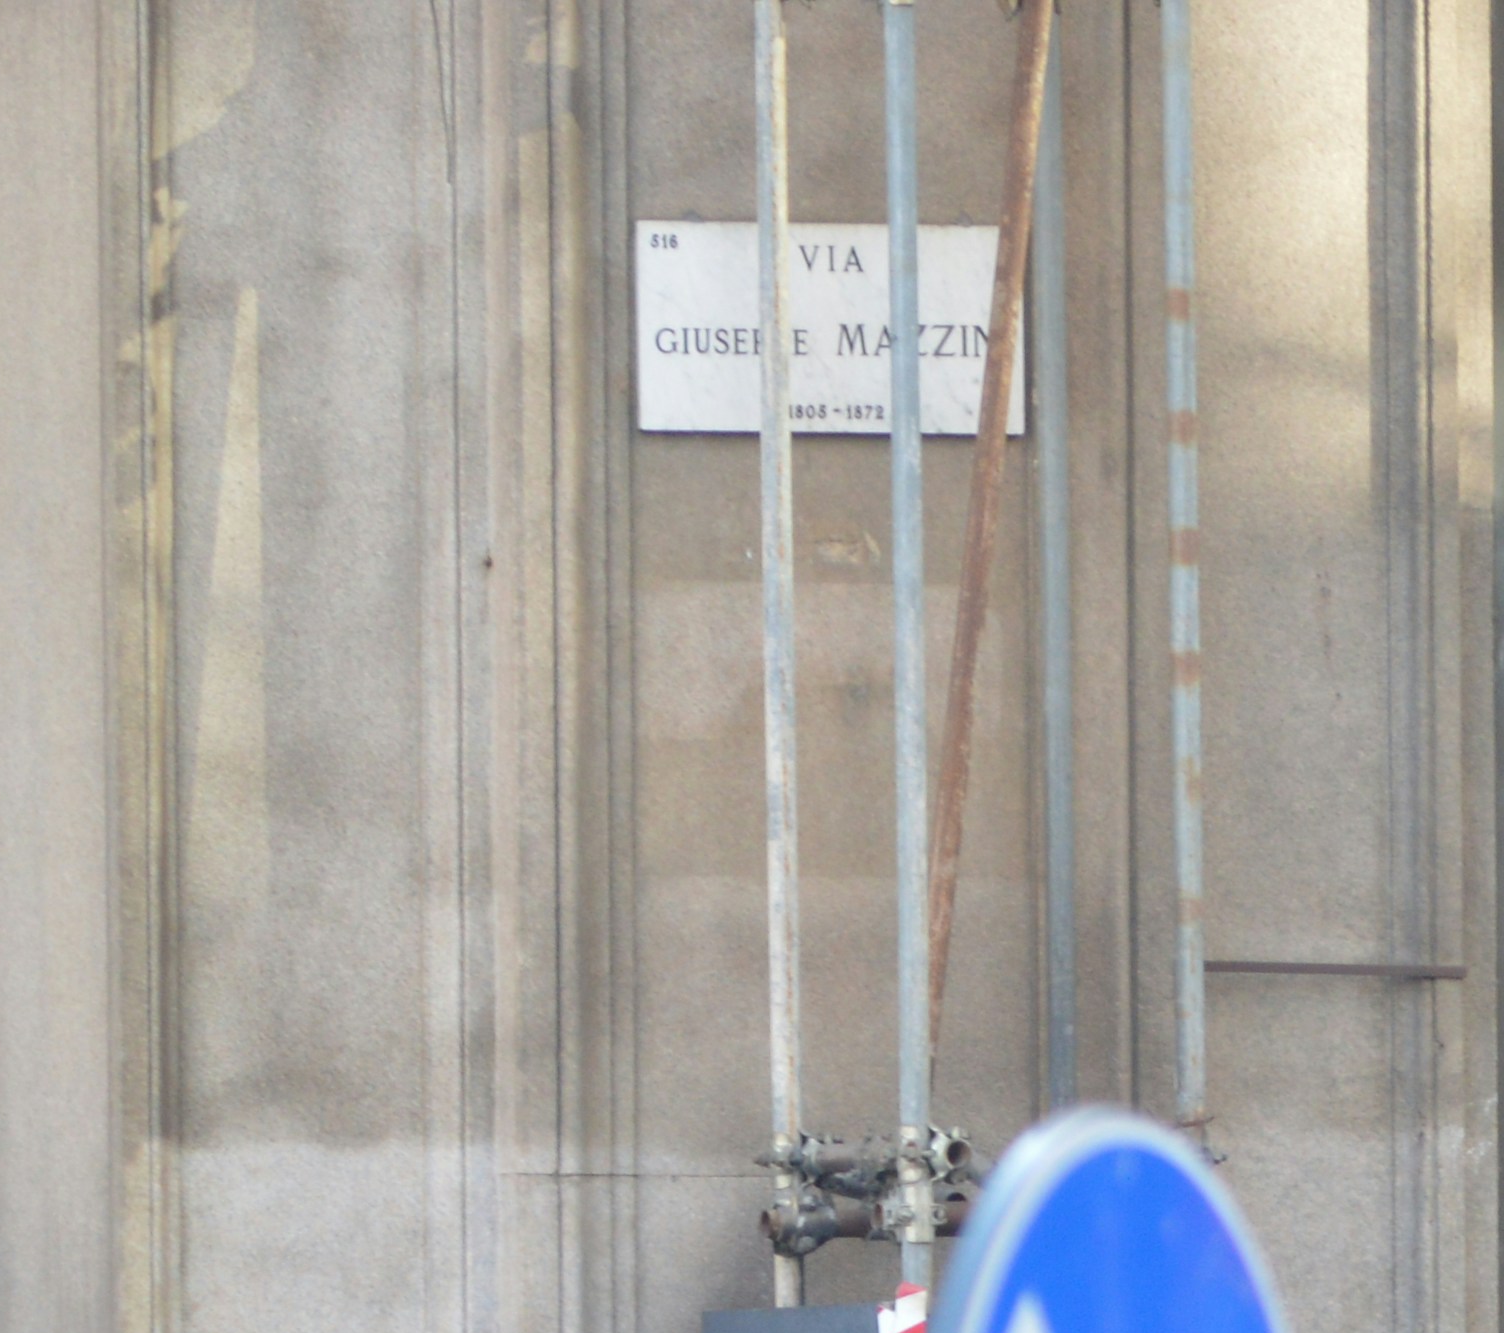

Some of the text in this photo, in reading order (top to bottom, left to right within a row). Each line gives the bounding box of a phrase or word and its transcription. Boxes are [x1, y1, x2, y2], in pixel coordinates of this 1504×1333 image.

[649, 233, 679, 250] 516
[799, 244, 865, 274] VIA
[654, 323, 992, 358] GIUSEE MAZZIN
